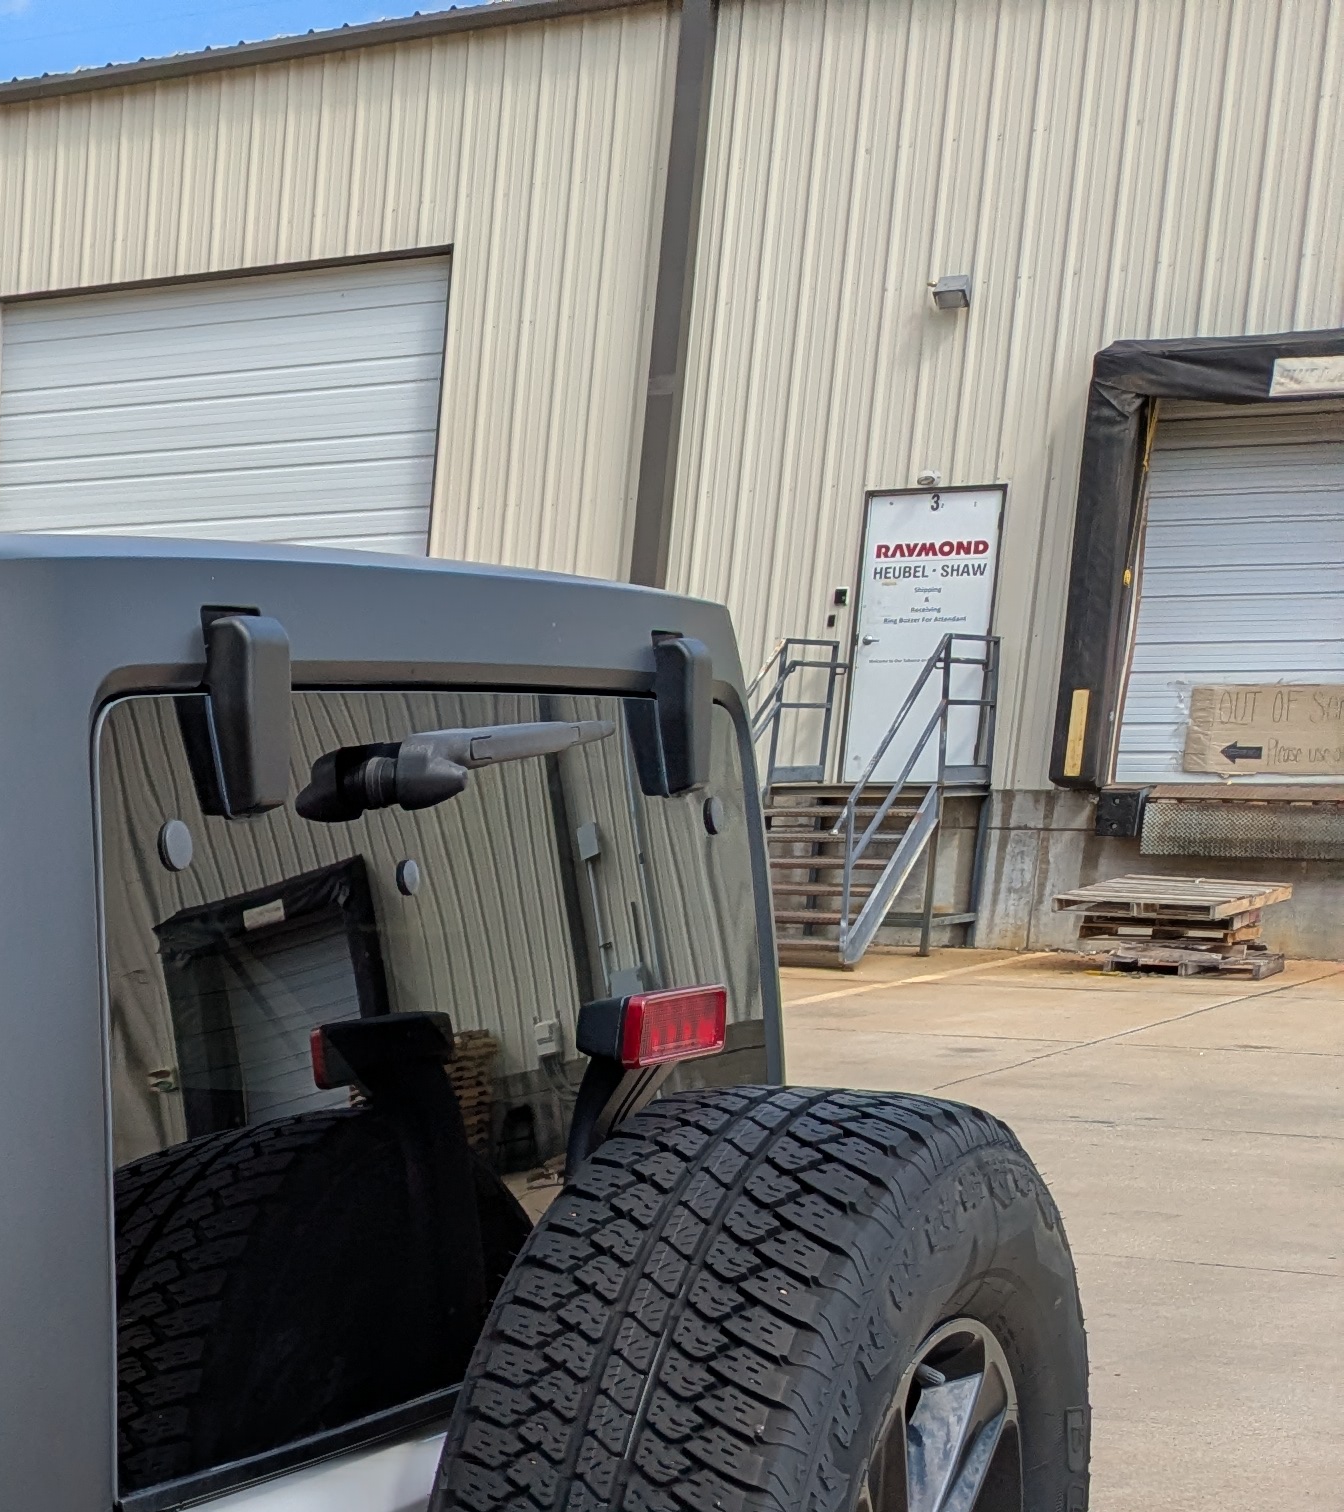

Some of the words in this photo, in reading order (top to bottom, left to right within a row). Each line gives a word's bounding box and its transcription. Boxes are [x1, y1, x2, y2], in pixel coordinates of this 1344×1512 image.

[930, 493, 941, 511] 3
[875, 540, 990, 558] RAYMOND
[873, 565, 929, 580] HEUBEL
[940, 563, 987, 578] SHAW
[883, 617, 898, 625] Ring
[1219, 690, 1263, 725] OUT
[1272, 690, 1304, 723] OF
